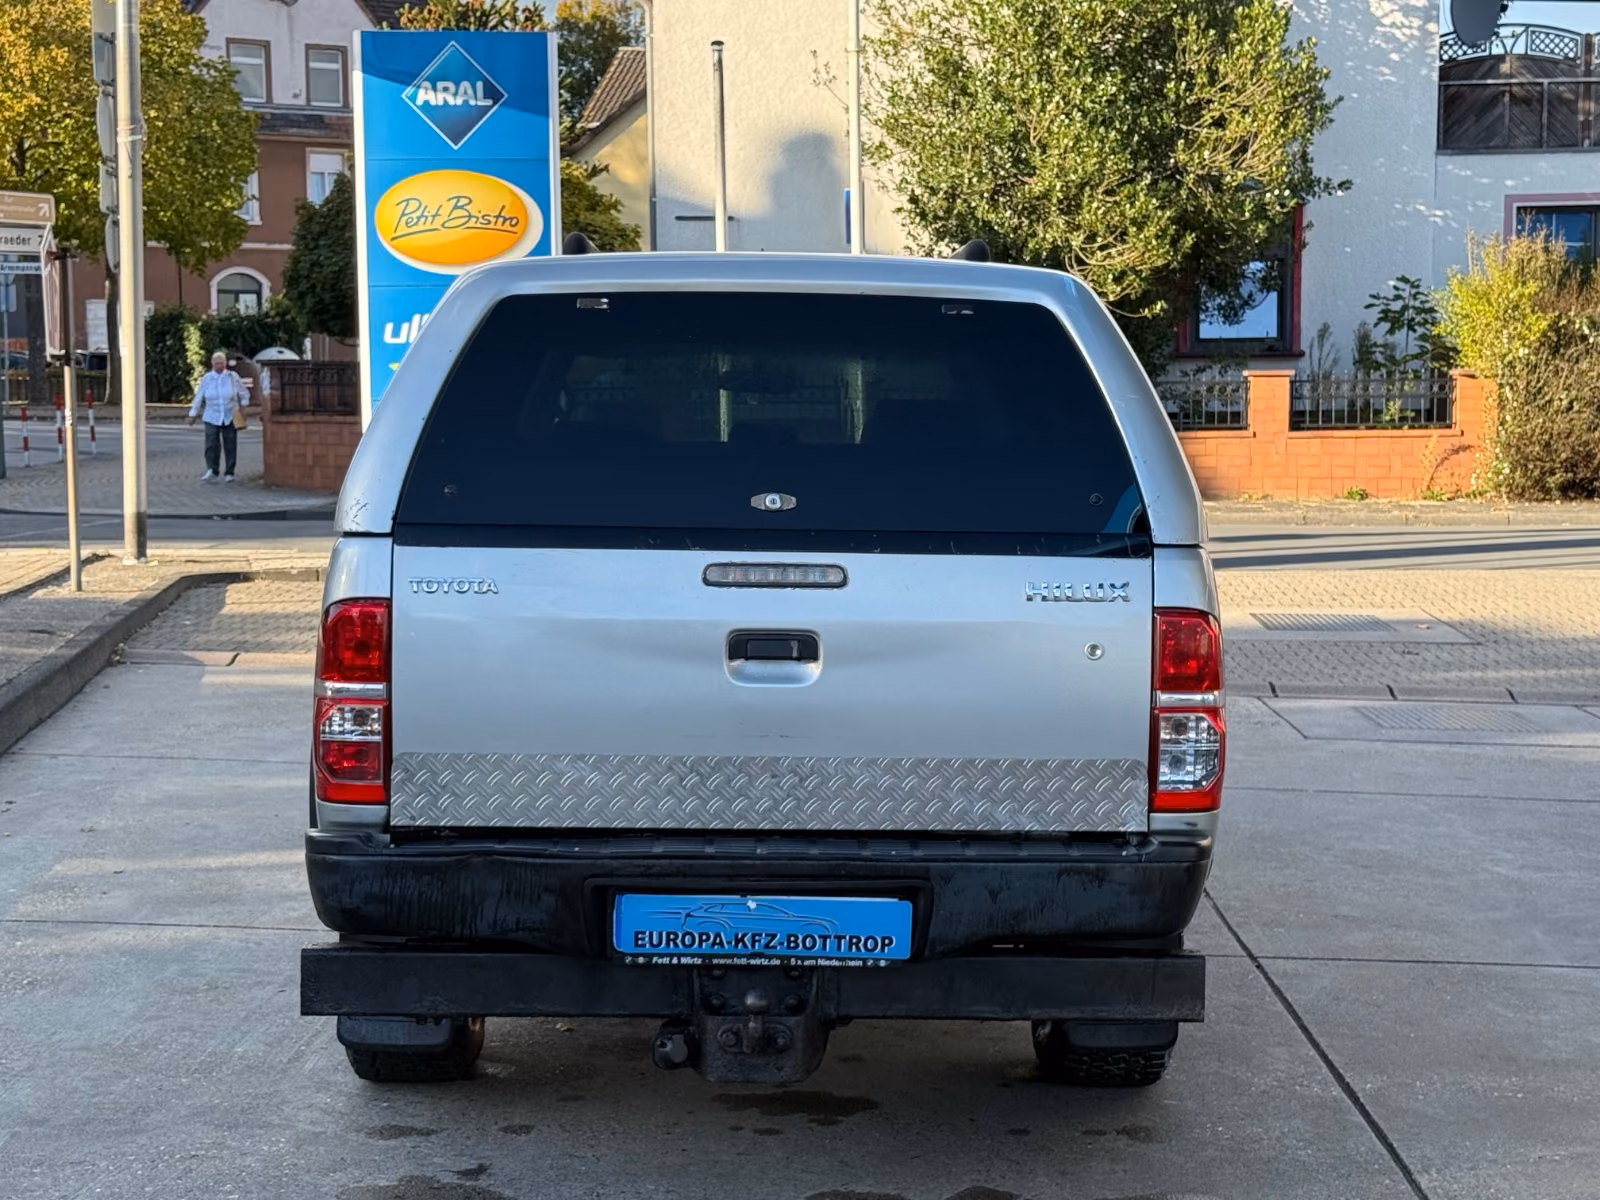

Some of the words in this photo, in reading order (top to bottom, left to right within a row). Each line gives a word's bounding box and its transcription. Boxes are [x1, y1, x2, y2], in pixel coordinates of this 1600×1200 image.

[416, 81, 493, 106] ARAL
[395, 198, 442, 233] Petit
[441, 196, 520, 228] Bistro
[408, 577, 499, 594] TOYOTA
[1025, 581, 1131, 602] HILUX
[633, 930, 895, 953] EUROPA-KFZ-BOTTROP
[652, 956, 669, 964] Fett
[671, 956, 678, 964] &
[680, 956, 703, 964] Wirtz
